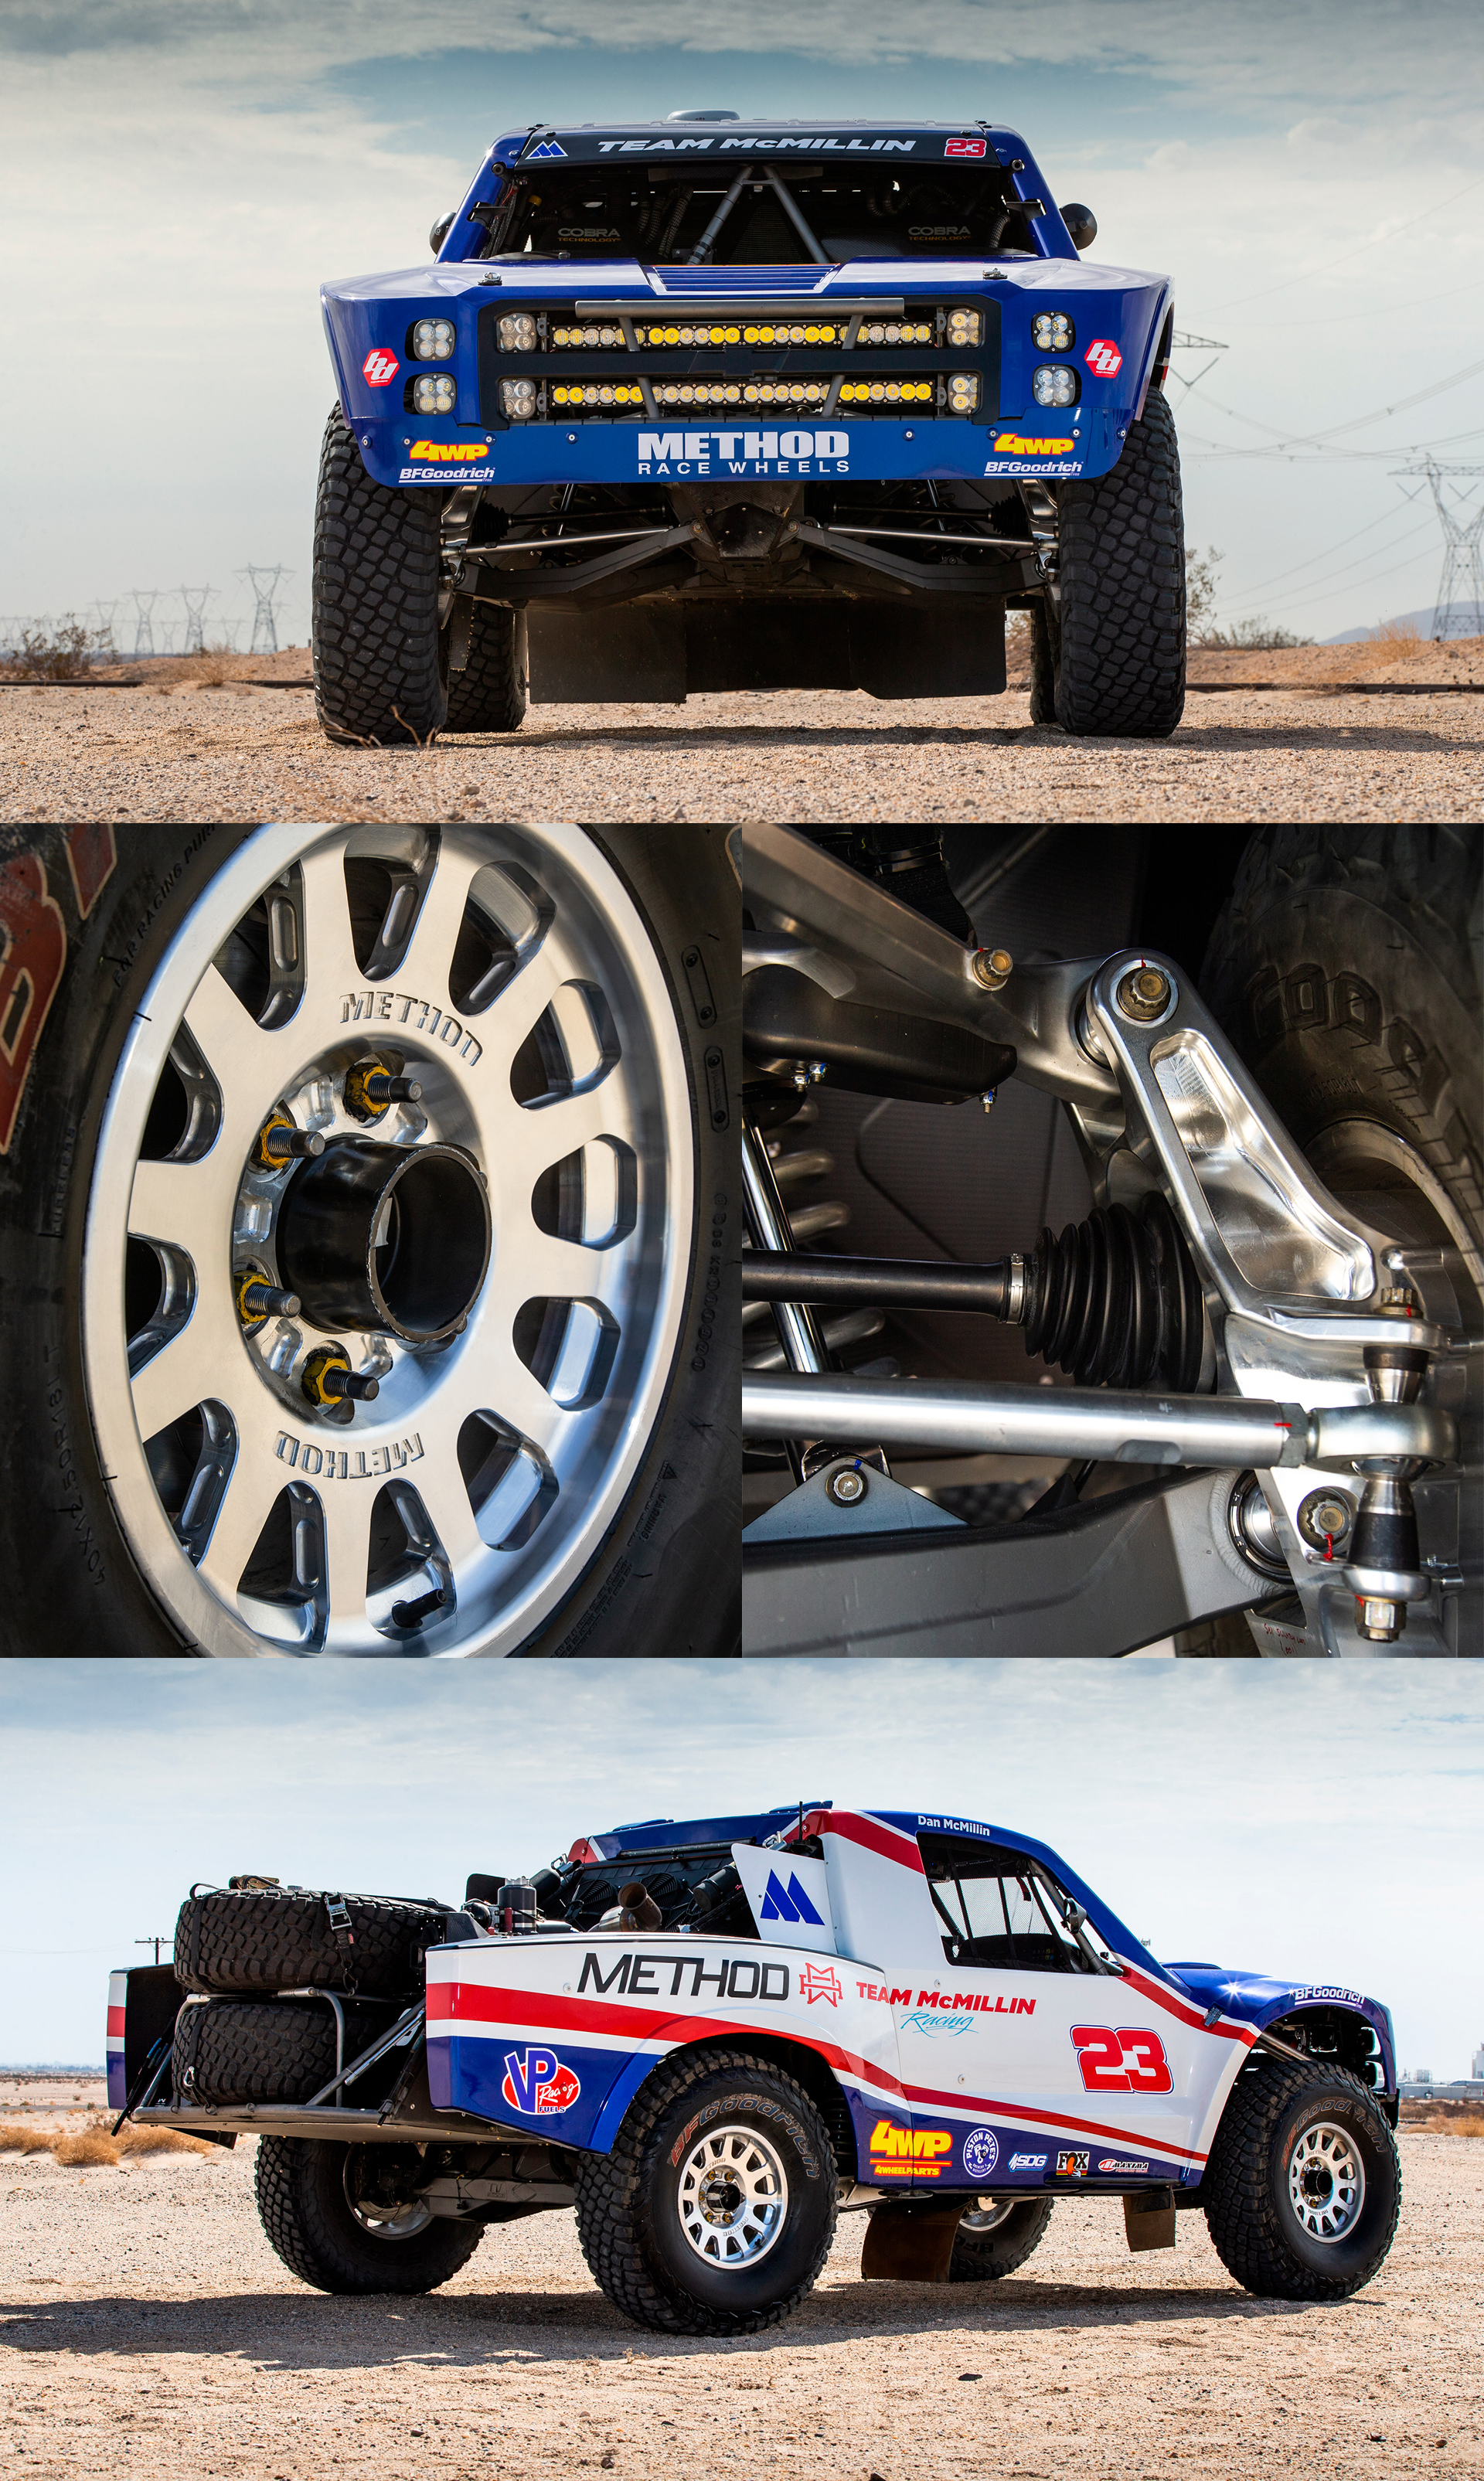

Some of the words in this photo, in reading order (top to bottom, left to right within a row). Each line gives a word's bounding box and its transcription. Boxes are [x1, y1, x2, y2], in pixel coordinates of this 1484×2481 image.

[598, 138, 715, 152] TEAM
[719, 138, 917, 151] McMILLIN
[944, 138, 987, 158] 23
[557, 227, 621, 237] COBRA
[908, 226, 971, 236] COBRA
[410, 440, 489, 462] 4WP
[638, 431, 849, 461] METHOD
[994, 433, 1074, 455] 4WP
[400, 467, 495, 479] BFGoodrich
[638, 462, 710, 475] RACE
[728, 460, 849, 474] WHEELS
[985, 461, 1082, 472] BFGoodrich
[137, 863, 182, 940] RACING
[183, 823, 216, 864] PUR
[339, 991, 483, 1067] METHOD
[272, 1430, 425, 1479] METHOD
[917, 1816, 941, 1828] Dan
[943, 1818, 990, 1836] McMillin
[577, 1952, 790, 2001] METHOD
[856, 1981, 913, 2006] TEAM
[916, 1990, 1036, 2015] McMILLIN
[1295, 1986, 1365, 2004] BFGoodrich
[900, 2010, 979, 2038] Racing
[1069, 2024, 1175, 2095] 23
[504, 2047, 559, 2115] VP
[870, 2119, 953, 2159] 4WP
[966, 2132, 983, 2159] PISTON
[1016, 2155, 1047, 2167] SDG
[1058, 2153, 1088, 2169] FOX
